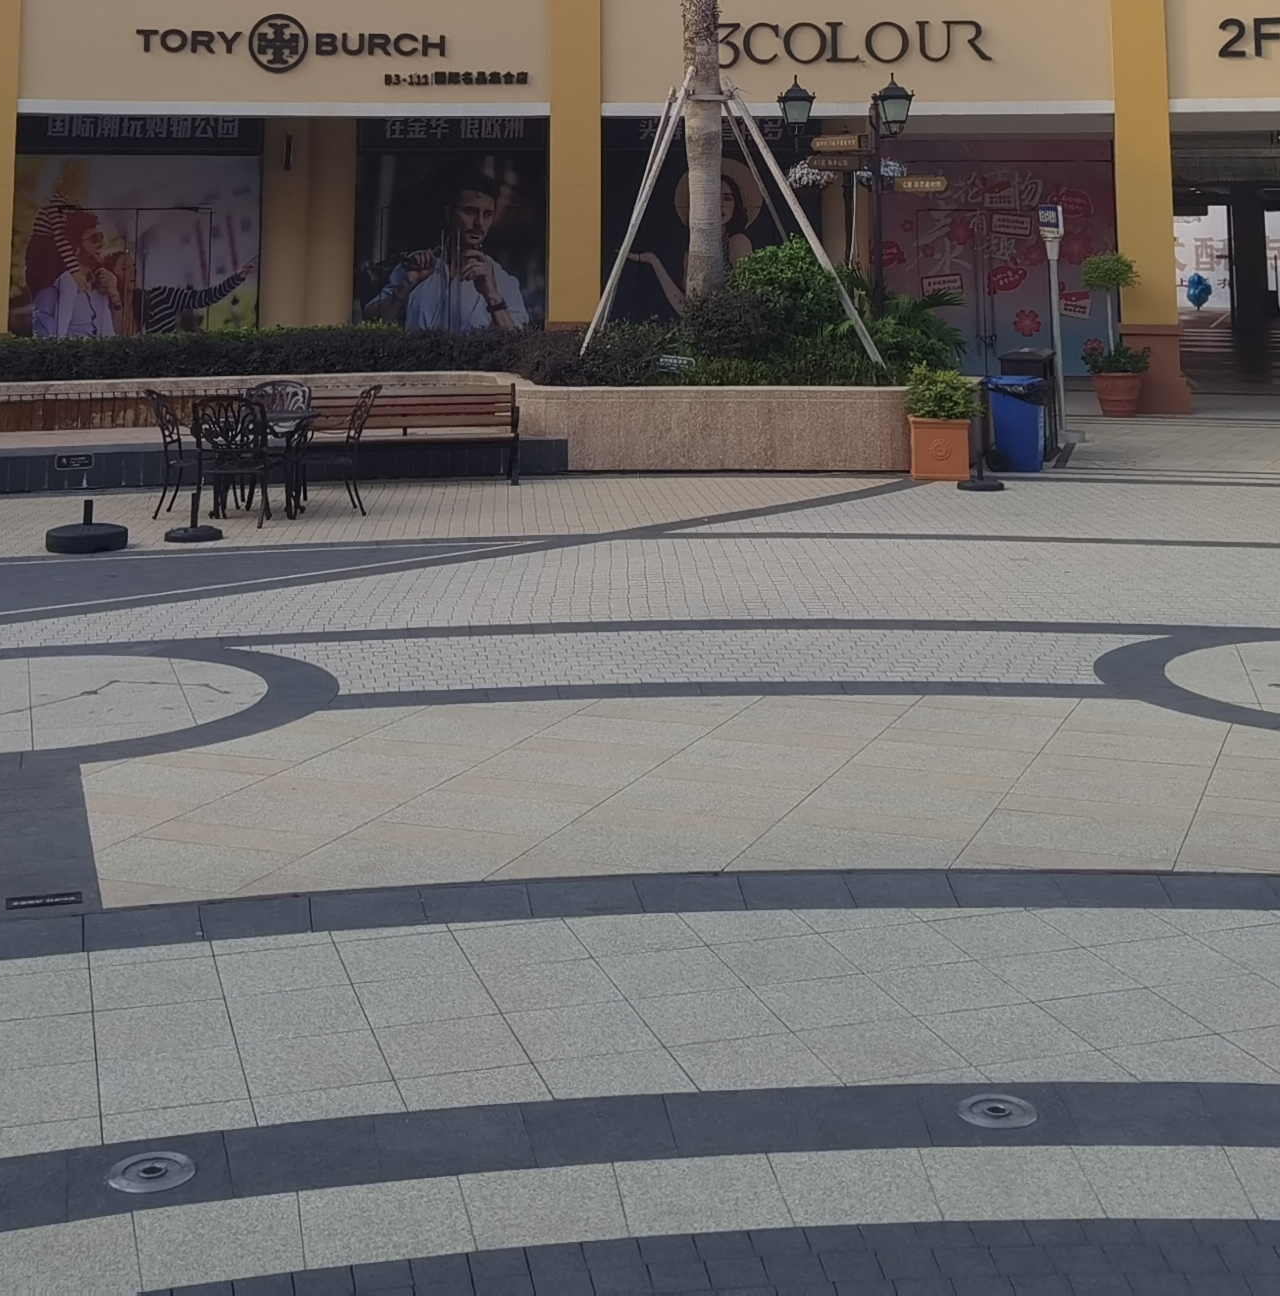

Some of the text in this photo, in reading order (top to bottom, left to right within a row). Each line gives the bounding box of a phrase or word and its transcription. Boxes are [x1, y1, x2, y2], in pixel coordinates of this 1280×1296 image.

[136, 28, 447, 57] TORY BURCH
[718, 20, 994, 69] 3COLOUR
[47, 115, 239, 138] 国际潮玩购物公园
[385, 117, 524, 140] 在金华 很欧洲
